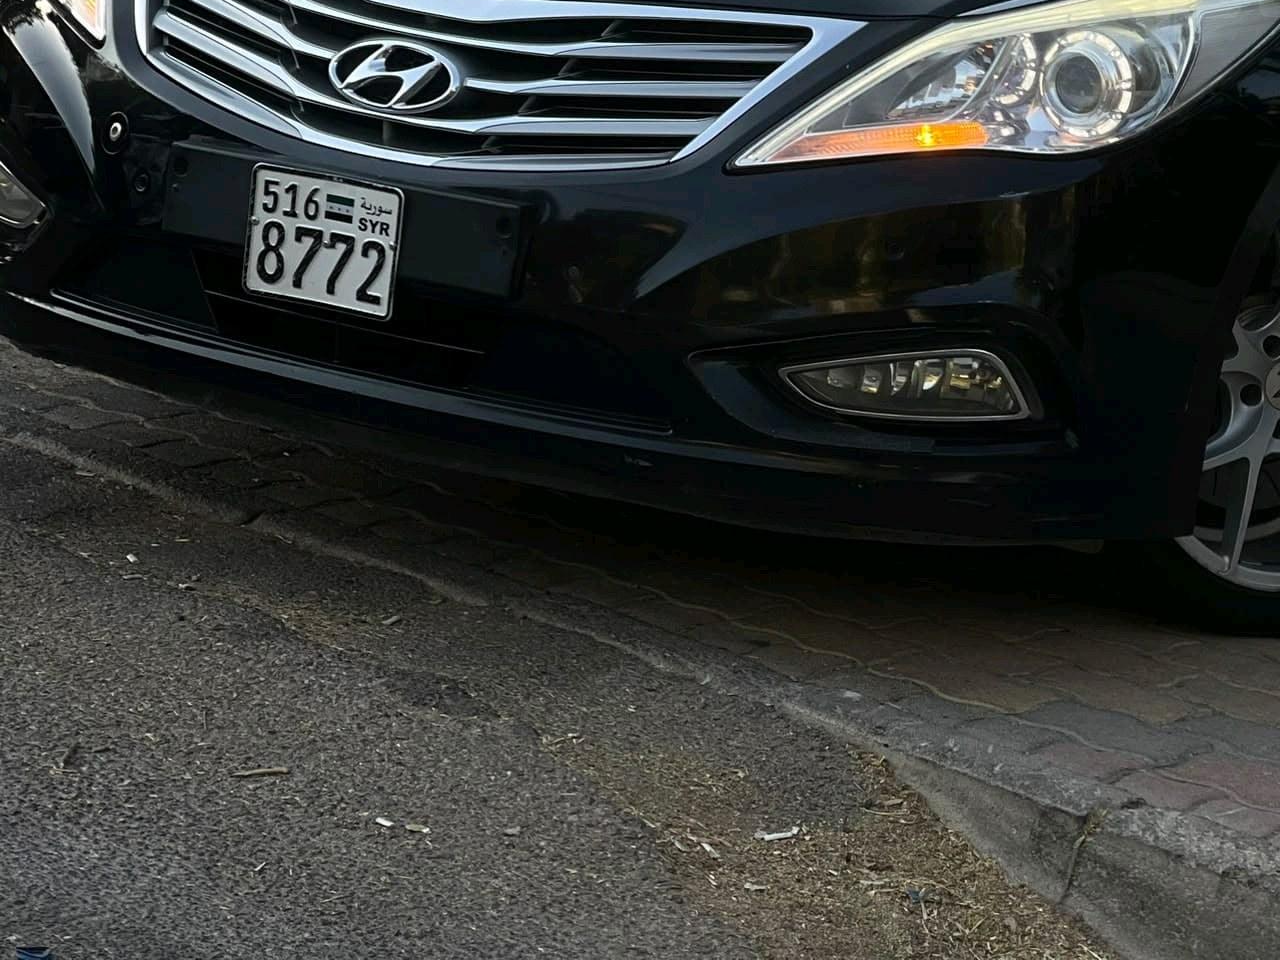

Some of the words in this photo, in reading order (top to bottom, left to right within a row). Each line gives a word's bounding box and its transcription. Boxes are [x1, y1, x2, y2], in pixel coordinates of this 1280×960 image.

[262, 179, 321, 221] 516
[360, 197, 393, 217] سورية
[358, 217, 391, 237] SYR
[256, 220, 386, 306] 8772
